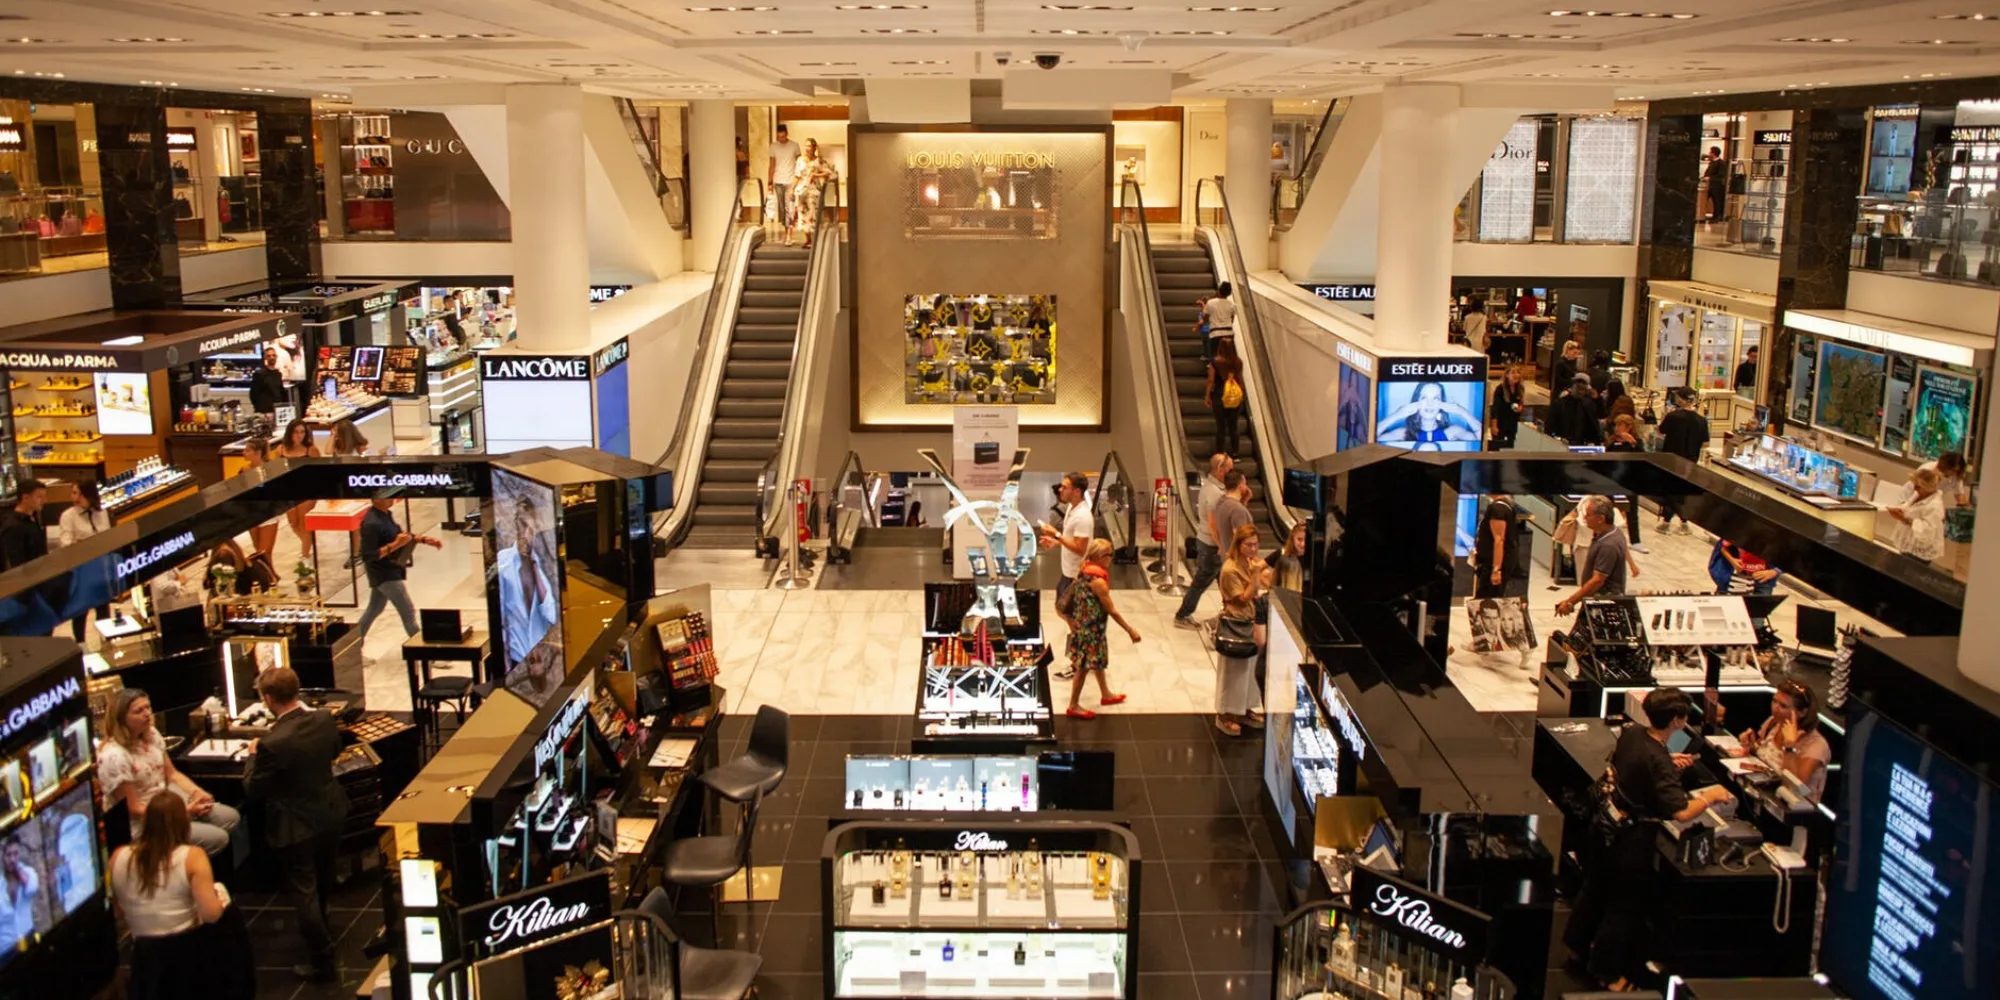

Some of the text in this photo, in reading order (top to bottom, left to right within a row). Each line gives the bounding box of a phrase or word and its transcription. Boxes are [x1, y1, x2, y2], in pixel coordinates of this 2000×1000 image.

[1491, 140, 1533, 159] Dior
[907, 152, 1055, 168] LOUIS VUITTON
[199, 337, 228, 353] ACQUA
[233, 329, 261, 344] PARMA
[0, 353, 118, 368] ACQUA DI PARMA
[485, 358, 588, 378] LANCÔME
[1428, 364, 1473, 375] LAUDER
[955, 831, 1008, 851] Kilian
[485, 896, 589, 945] Kilian
[1371, 883, 1466, 949] Kilian
